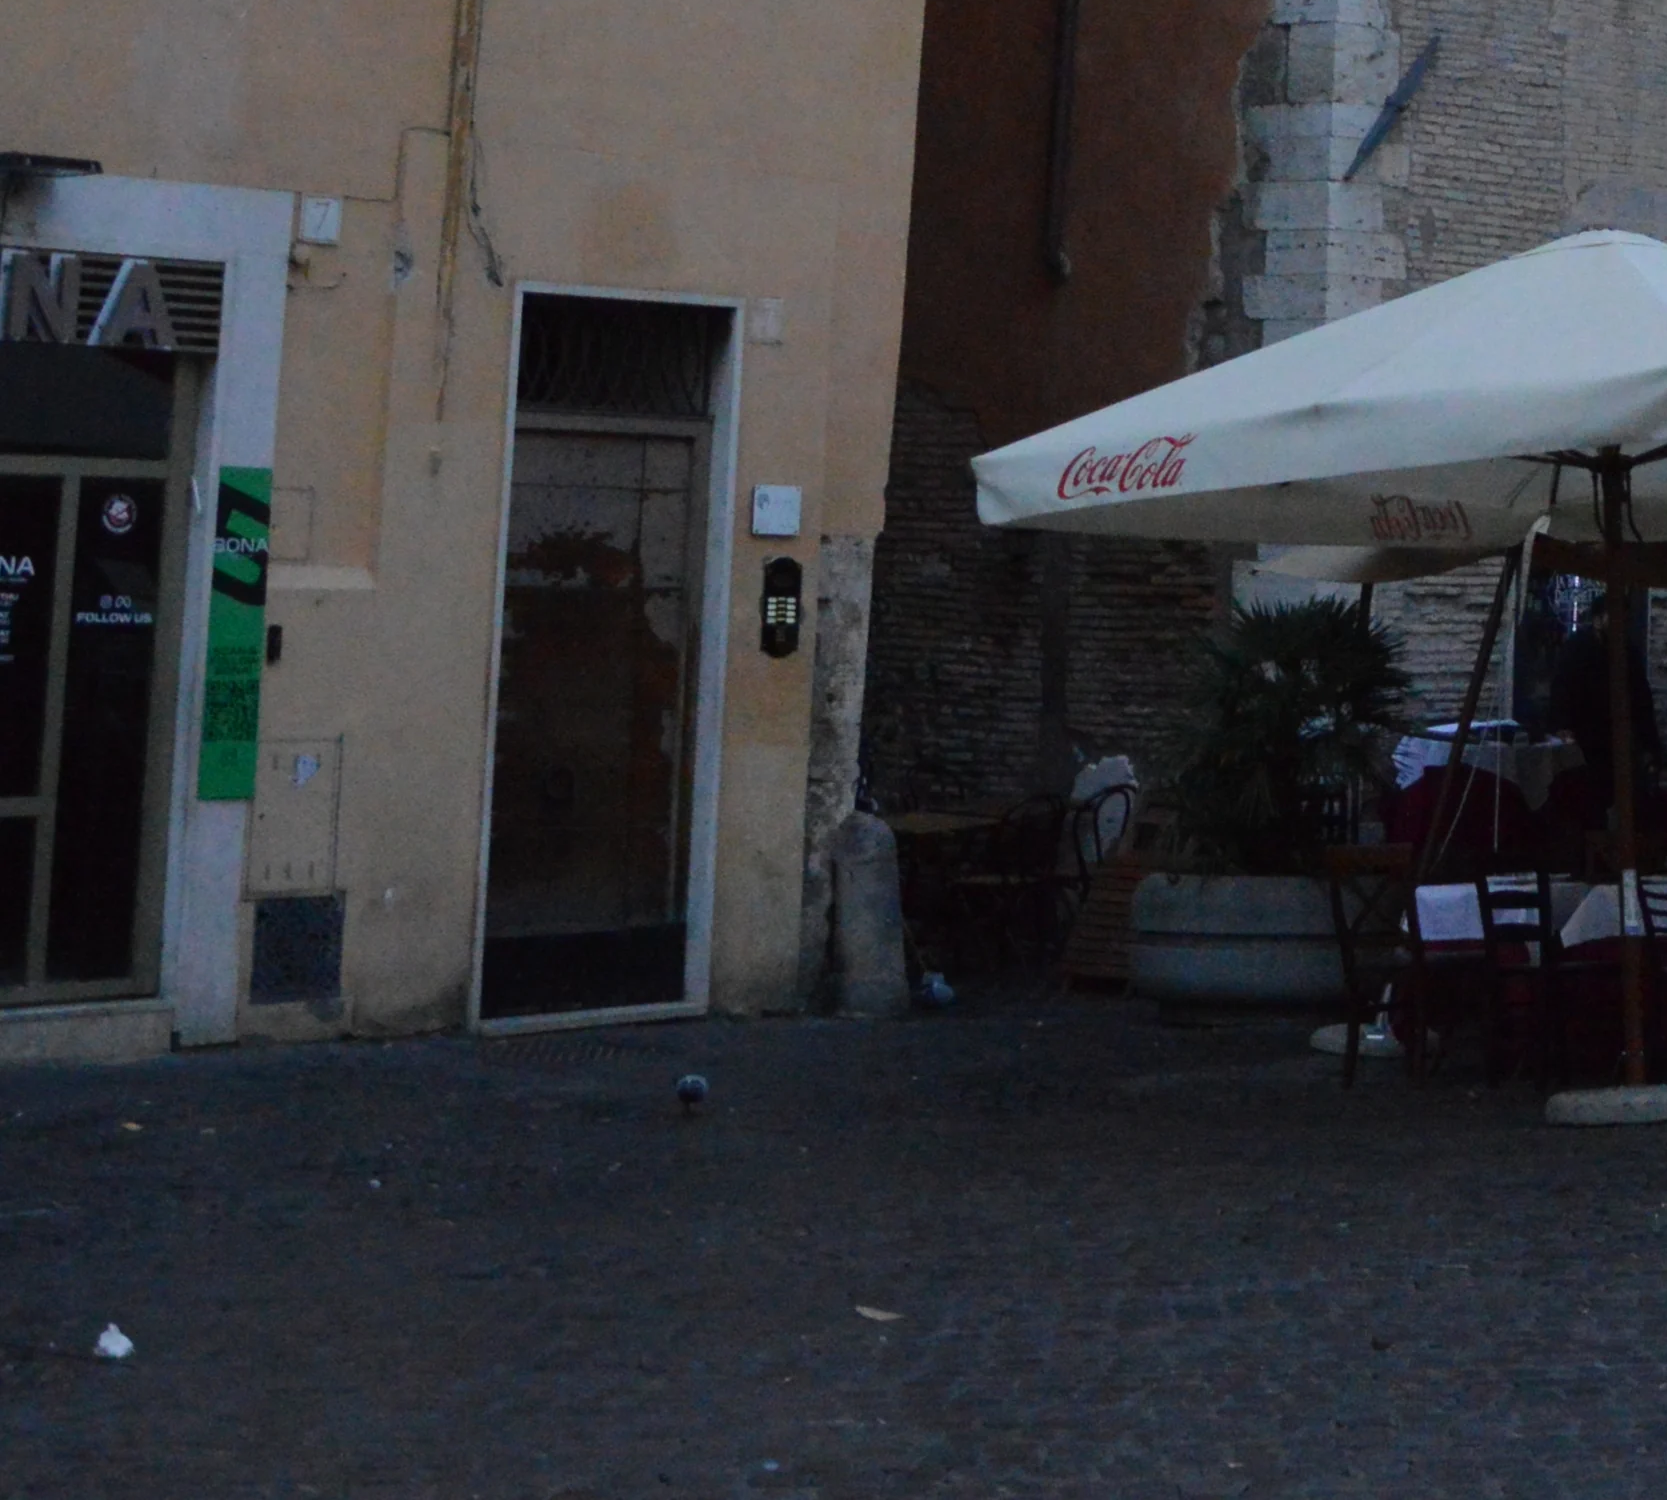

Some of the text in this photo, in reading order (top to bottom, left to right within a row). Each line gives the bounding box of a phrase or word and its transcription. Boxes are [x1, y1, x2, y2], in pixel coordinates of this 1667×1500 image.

[214, 537, 269, 553] BONA
[76, 612, 153, 624] FOLLOW US
